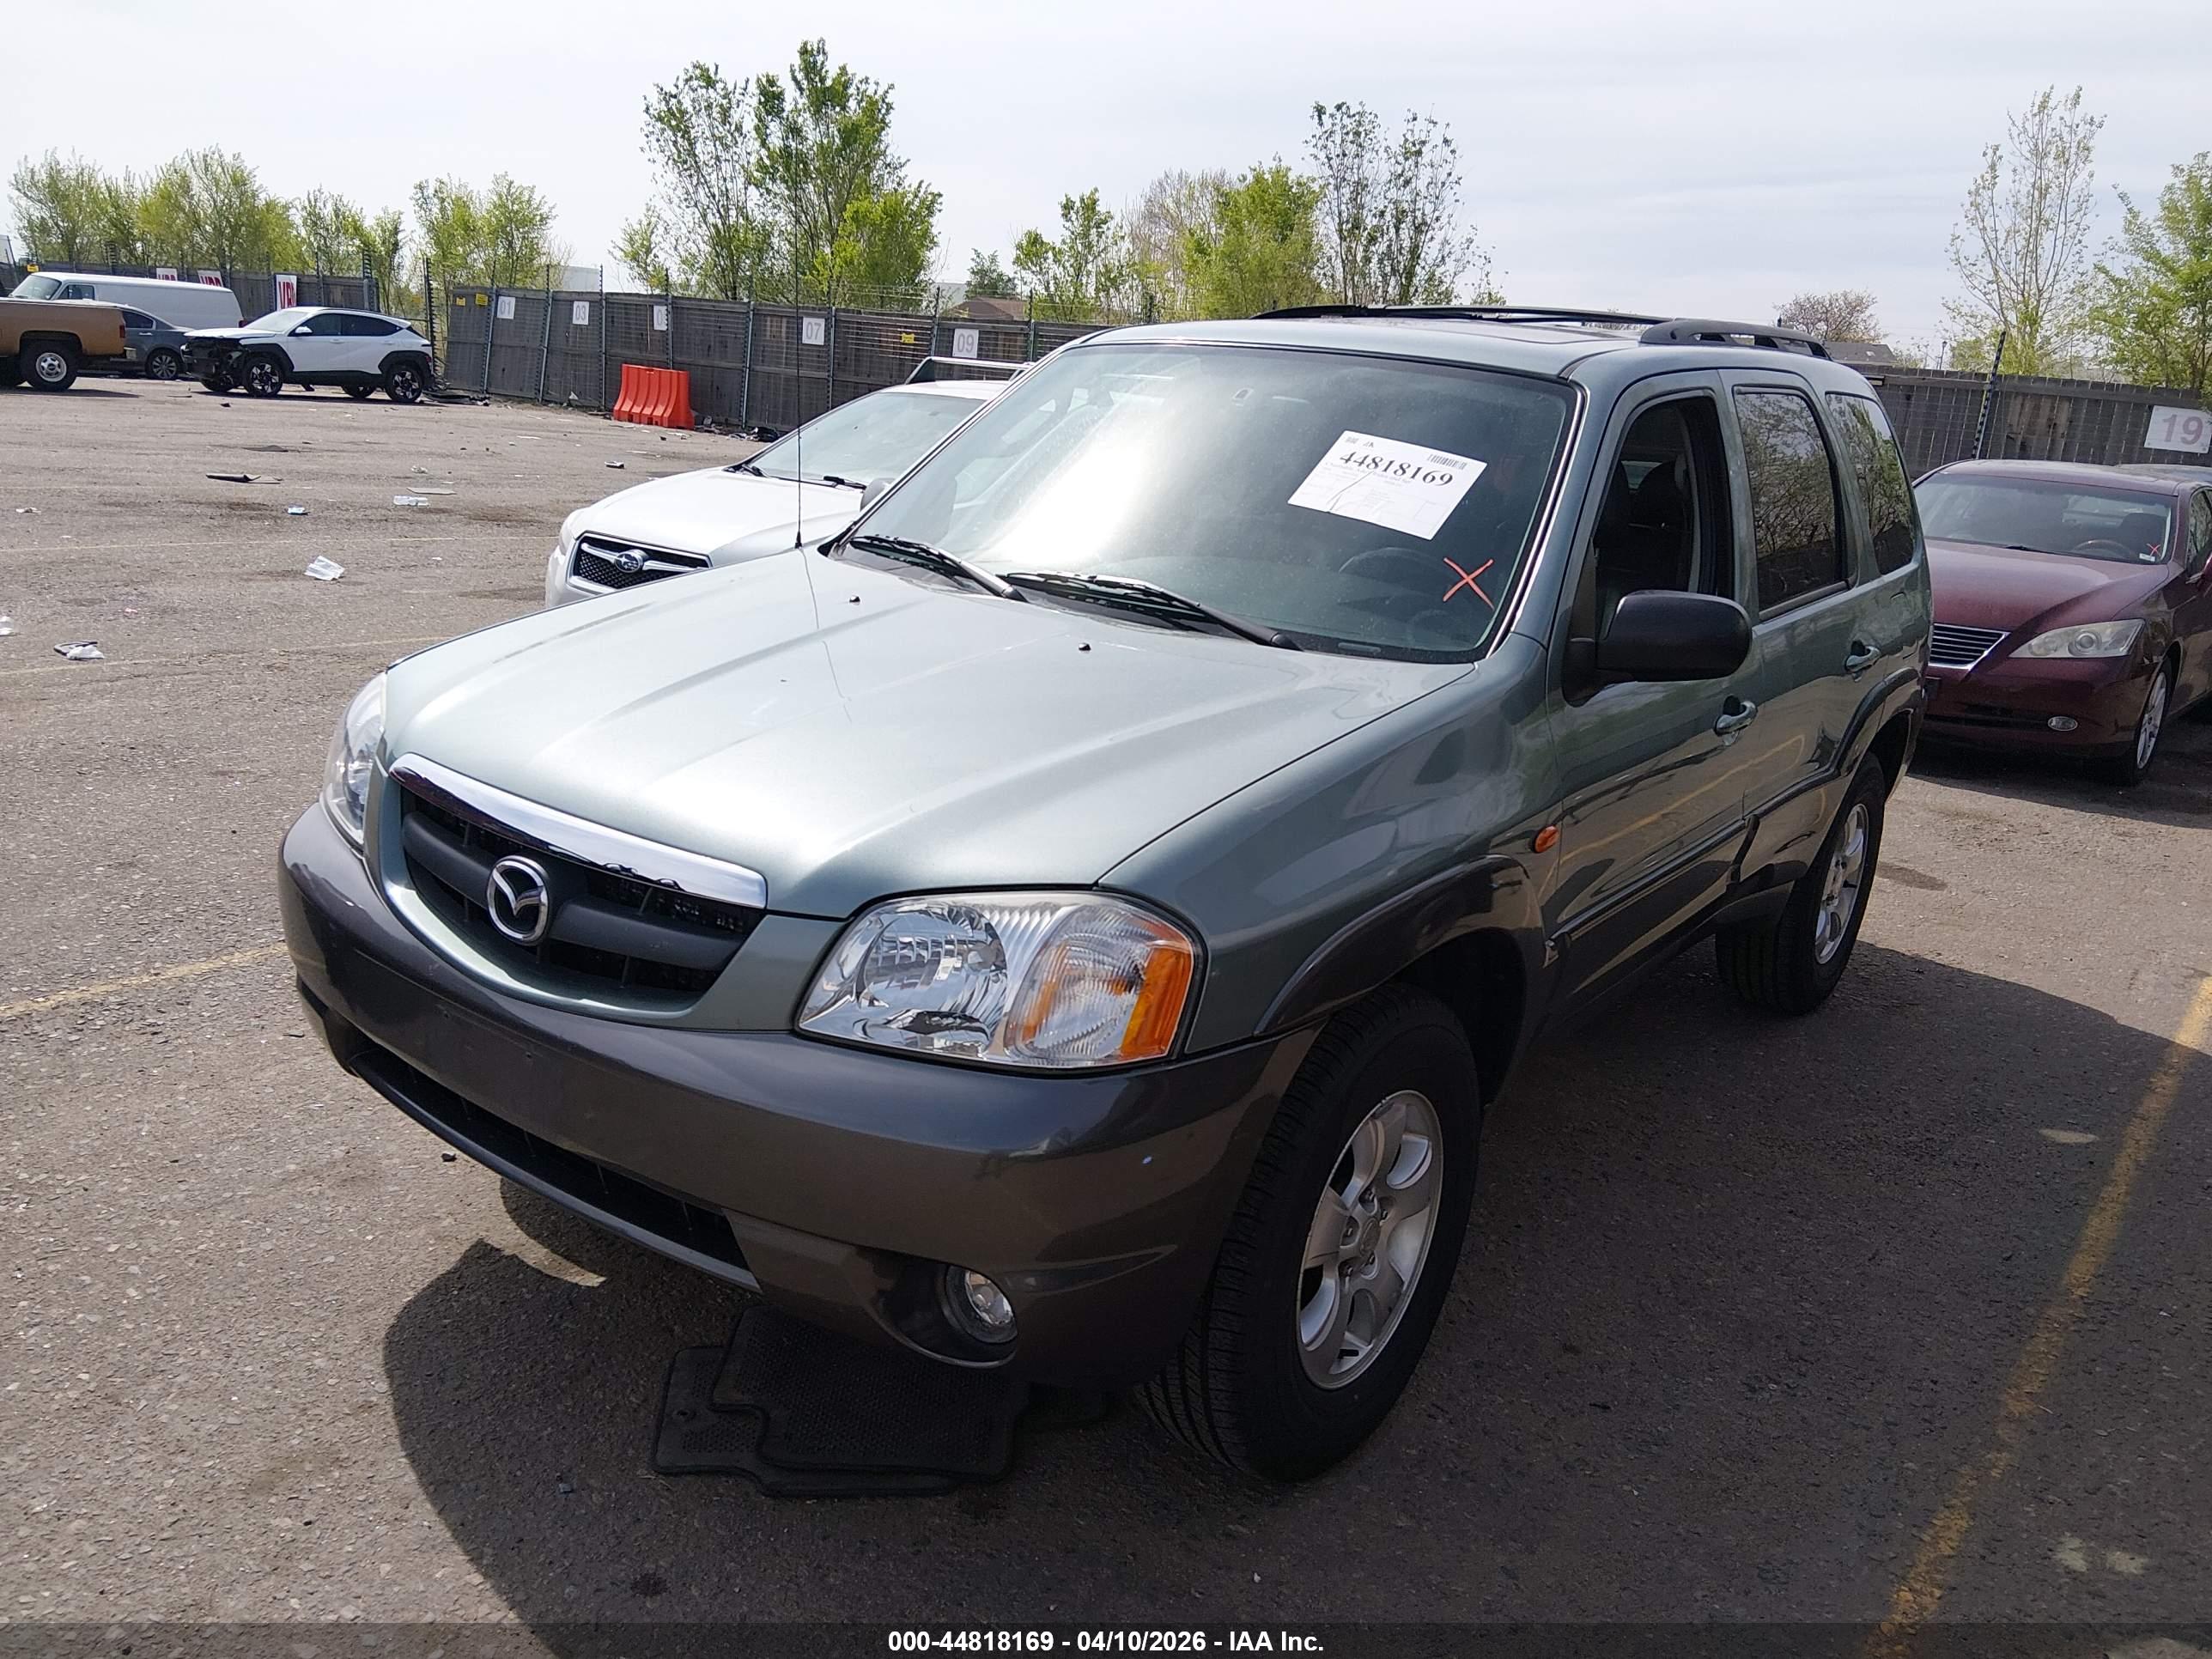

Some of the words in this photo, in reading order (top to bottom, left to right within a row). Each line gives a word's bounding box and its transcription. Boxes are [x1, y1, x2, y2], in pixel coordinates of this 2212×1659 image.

[805, 323, 822, 340] 07
[957, 334, 975, 353] 09
[2162, 413, 2203, 446] 19
[1339, 451, 1454, 487] 44818169
